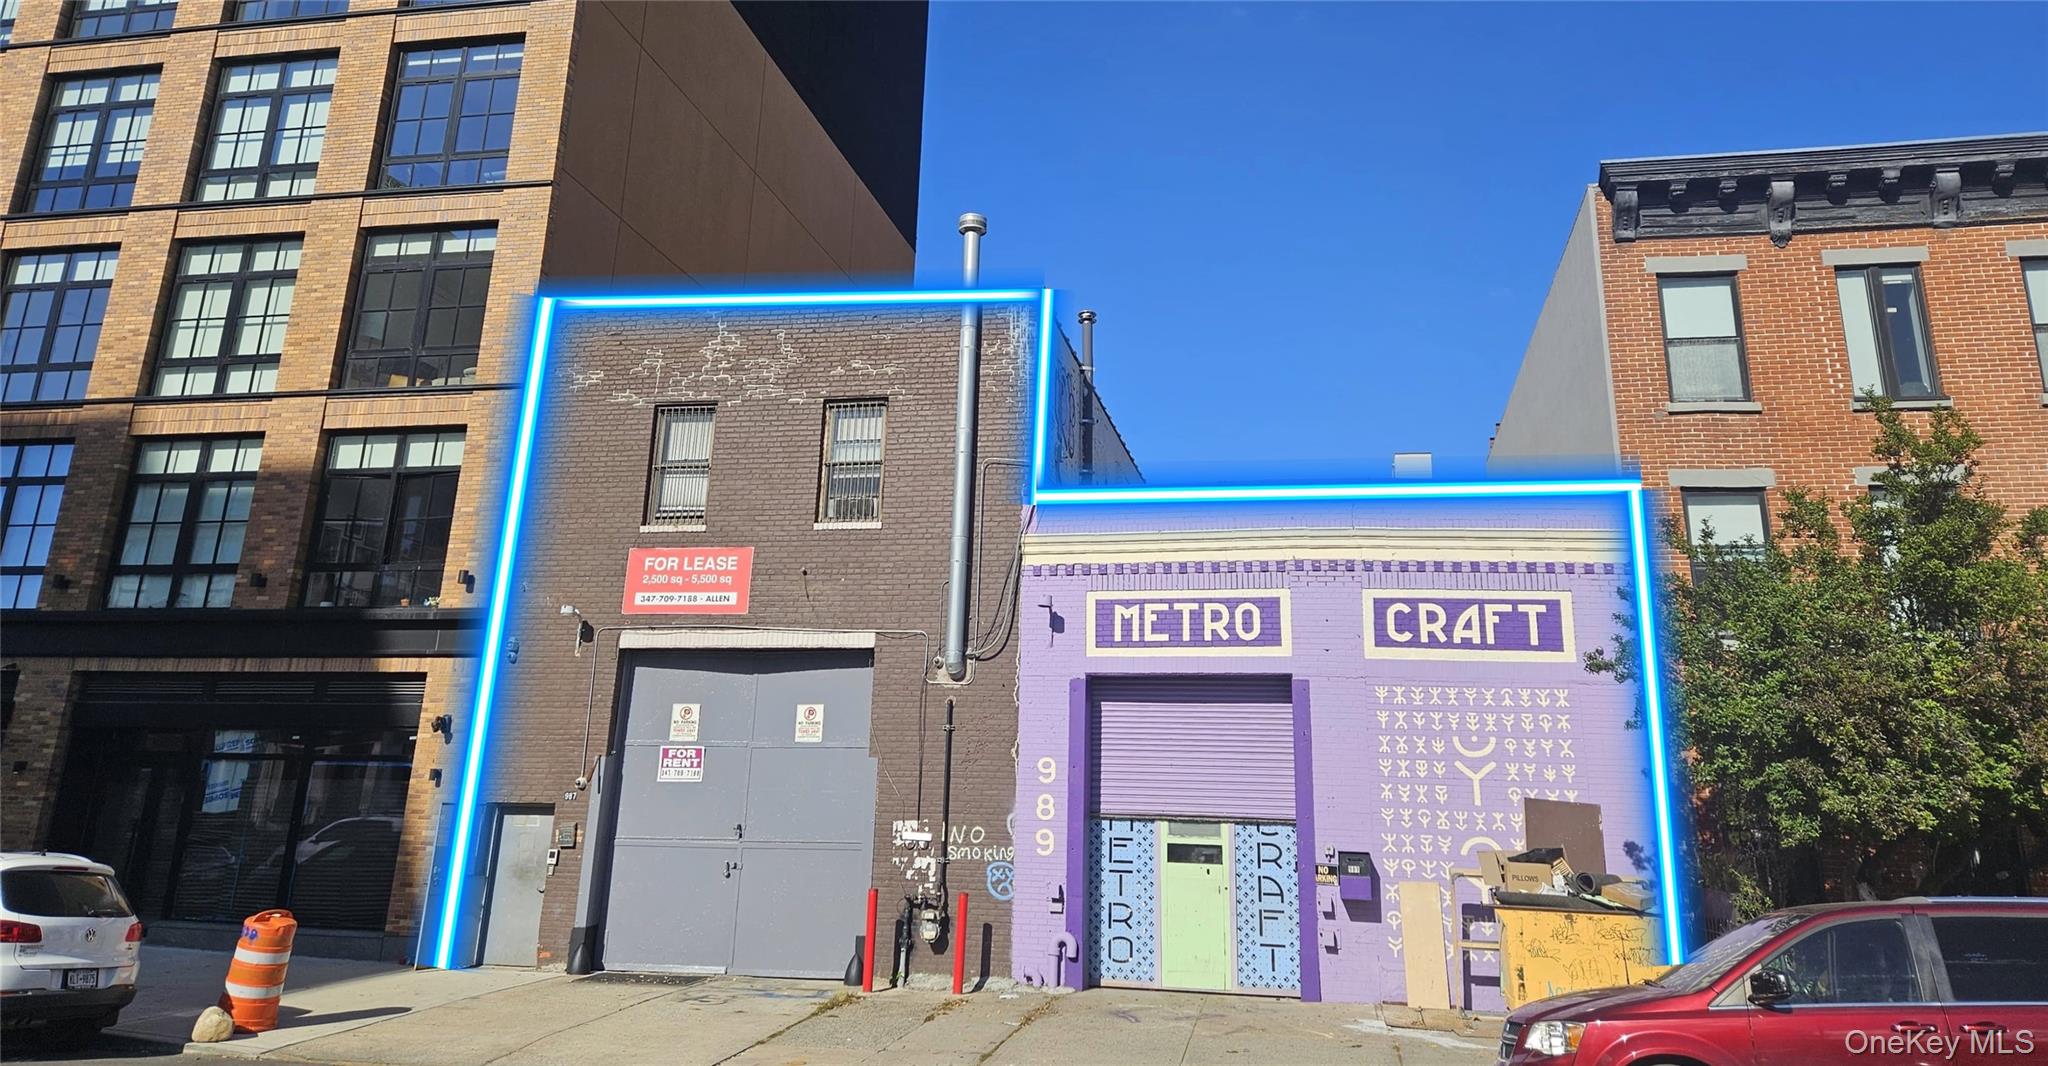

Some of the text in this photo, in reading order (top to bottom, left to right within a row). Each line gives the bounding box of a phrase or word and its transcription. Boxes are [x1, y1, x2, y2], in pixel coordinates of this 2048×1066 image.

[644, 556, 738, 571] FOR LEASE
[642, 574, 668, 585] 2,500
[671, 576, 683, 585] sq
[691, 574, 717, 585] 5,500
[720, 576, 732, 585] sq
[640, 595, 698, 603] 347-709-7188
[1114, 602, 1261, 642] METRO
[1386, 602, 1547, 646] CRAFT
[668, 749, 696, 758] FOR
[663, 758, 700, 768] RENT
[950, 825, 985, 843] NO
[1318, 866, 1329, 874] NO
[1512, 874, 1539, 882] PILLOWS
